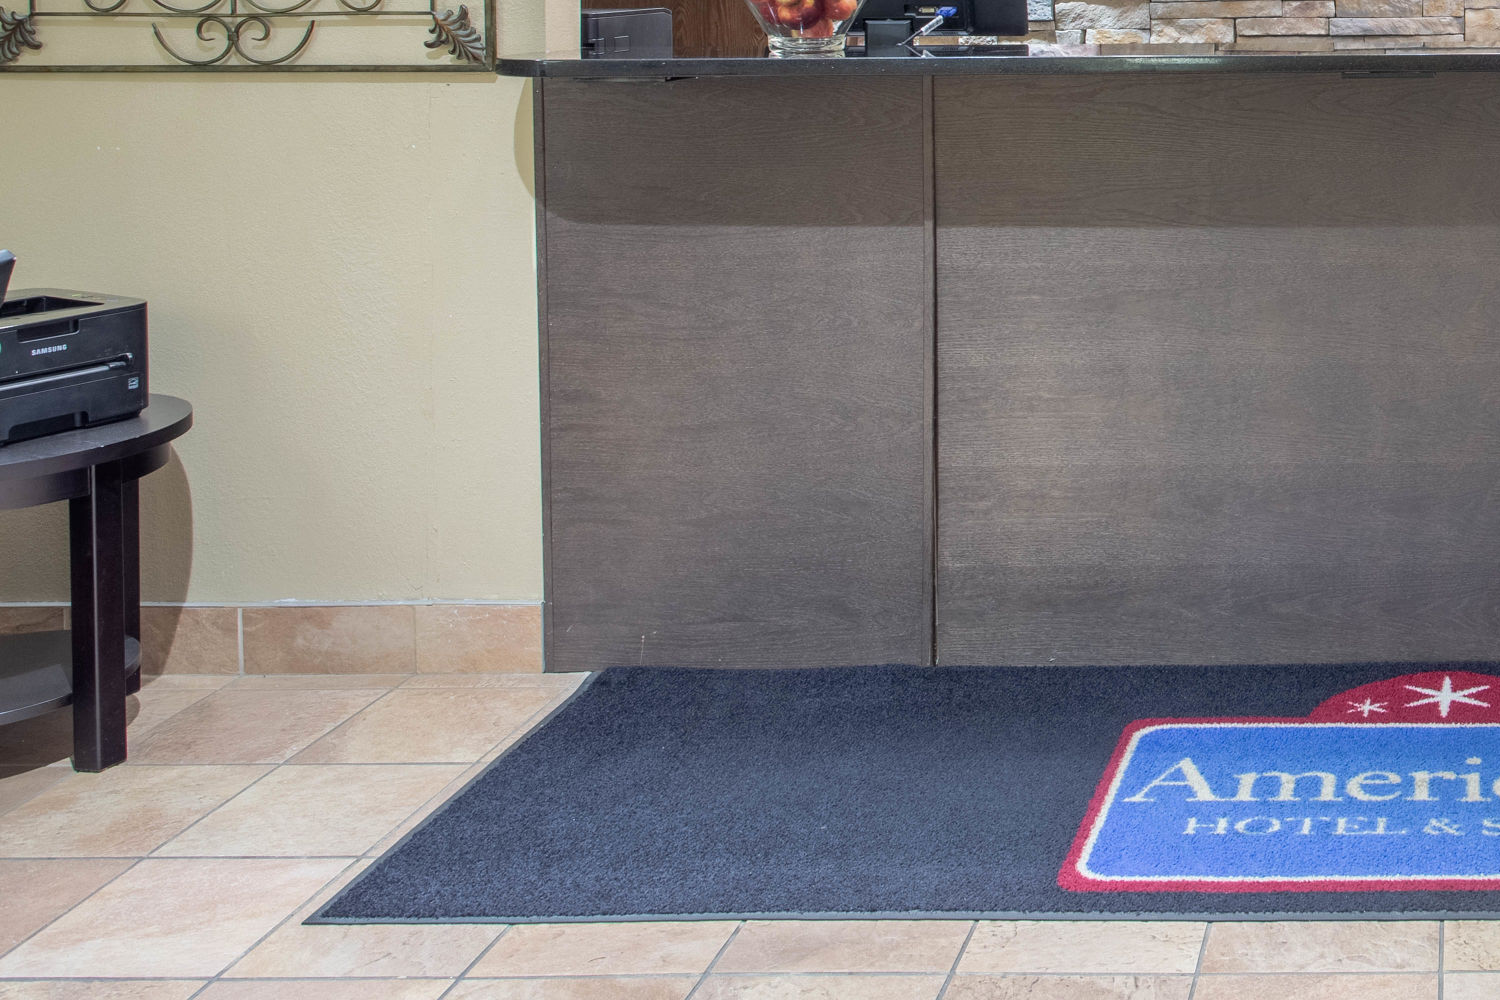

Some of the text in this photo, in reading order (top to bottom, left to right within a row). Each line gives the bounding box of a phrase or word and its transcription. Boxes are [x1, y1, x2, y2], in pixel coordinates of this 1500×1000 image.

[31, 344, 68, 356] SAMSUNG
[1182, 816, 1407, 836] HOTEL
[1422, 817, 1465, 836] &
